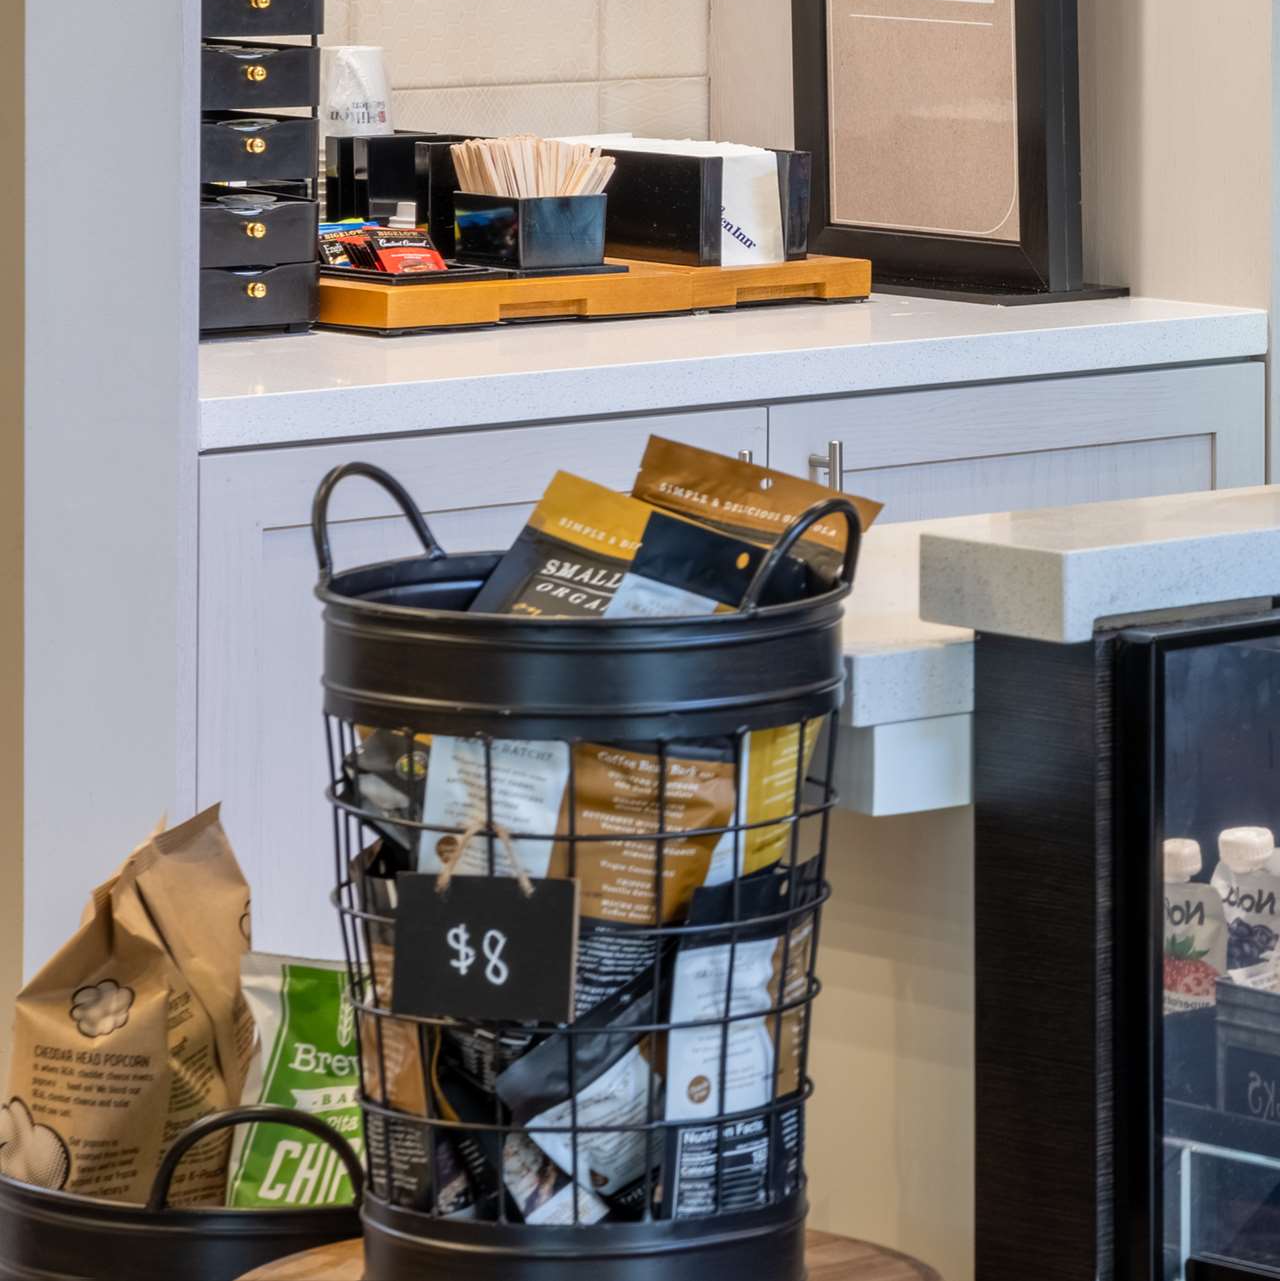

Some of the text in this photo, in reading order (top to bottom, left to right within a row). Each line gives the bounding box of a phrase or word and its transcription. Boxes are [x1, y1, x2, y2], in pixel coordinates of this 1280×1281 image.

[732, 227, 754, 248] Inn
[659, 482, 708, 505] SIMPLE
[540, 558, 624, 588] SMALL
[446, 922, 510, 986] $8
[34, 1044, 150, 1068] CHEDDAR HEAD POPCORN
